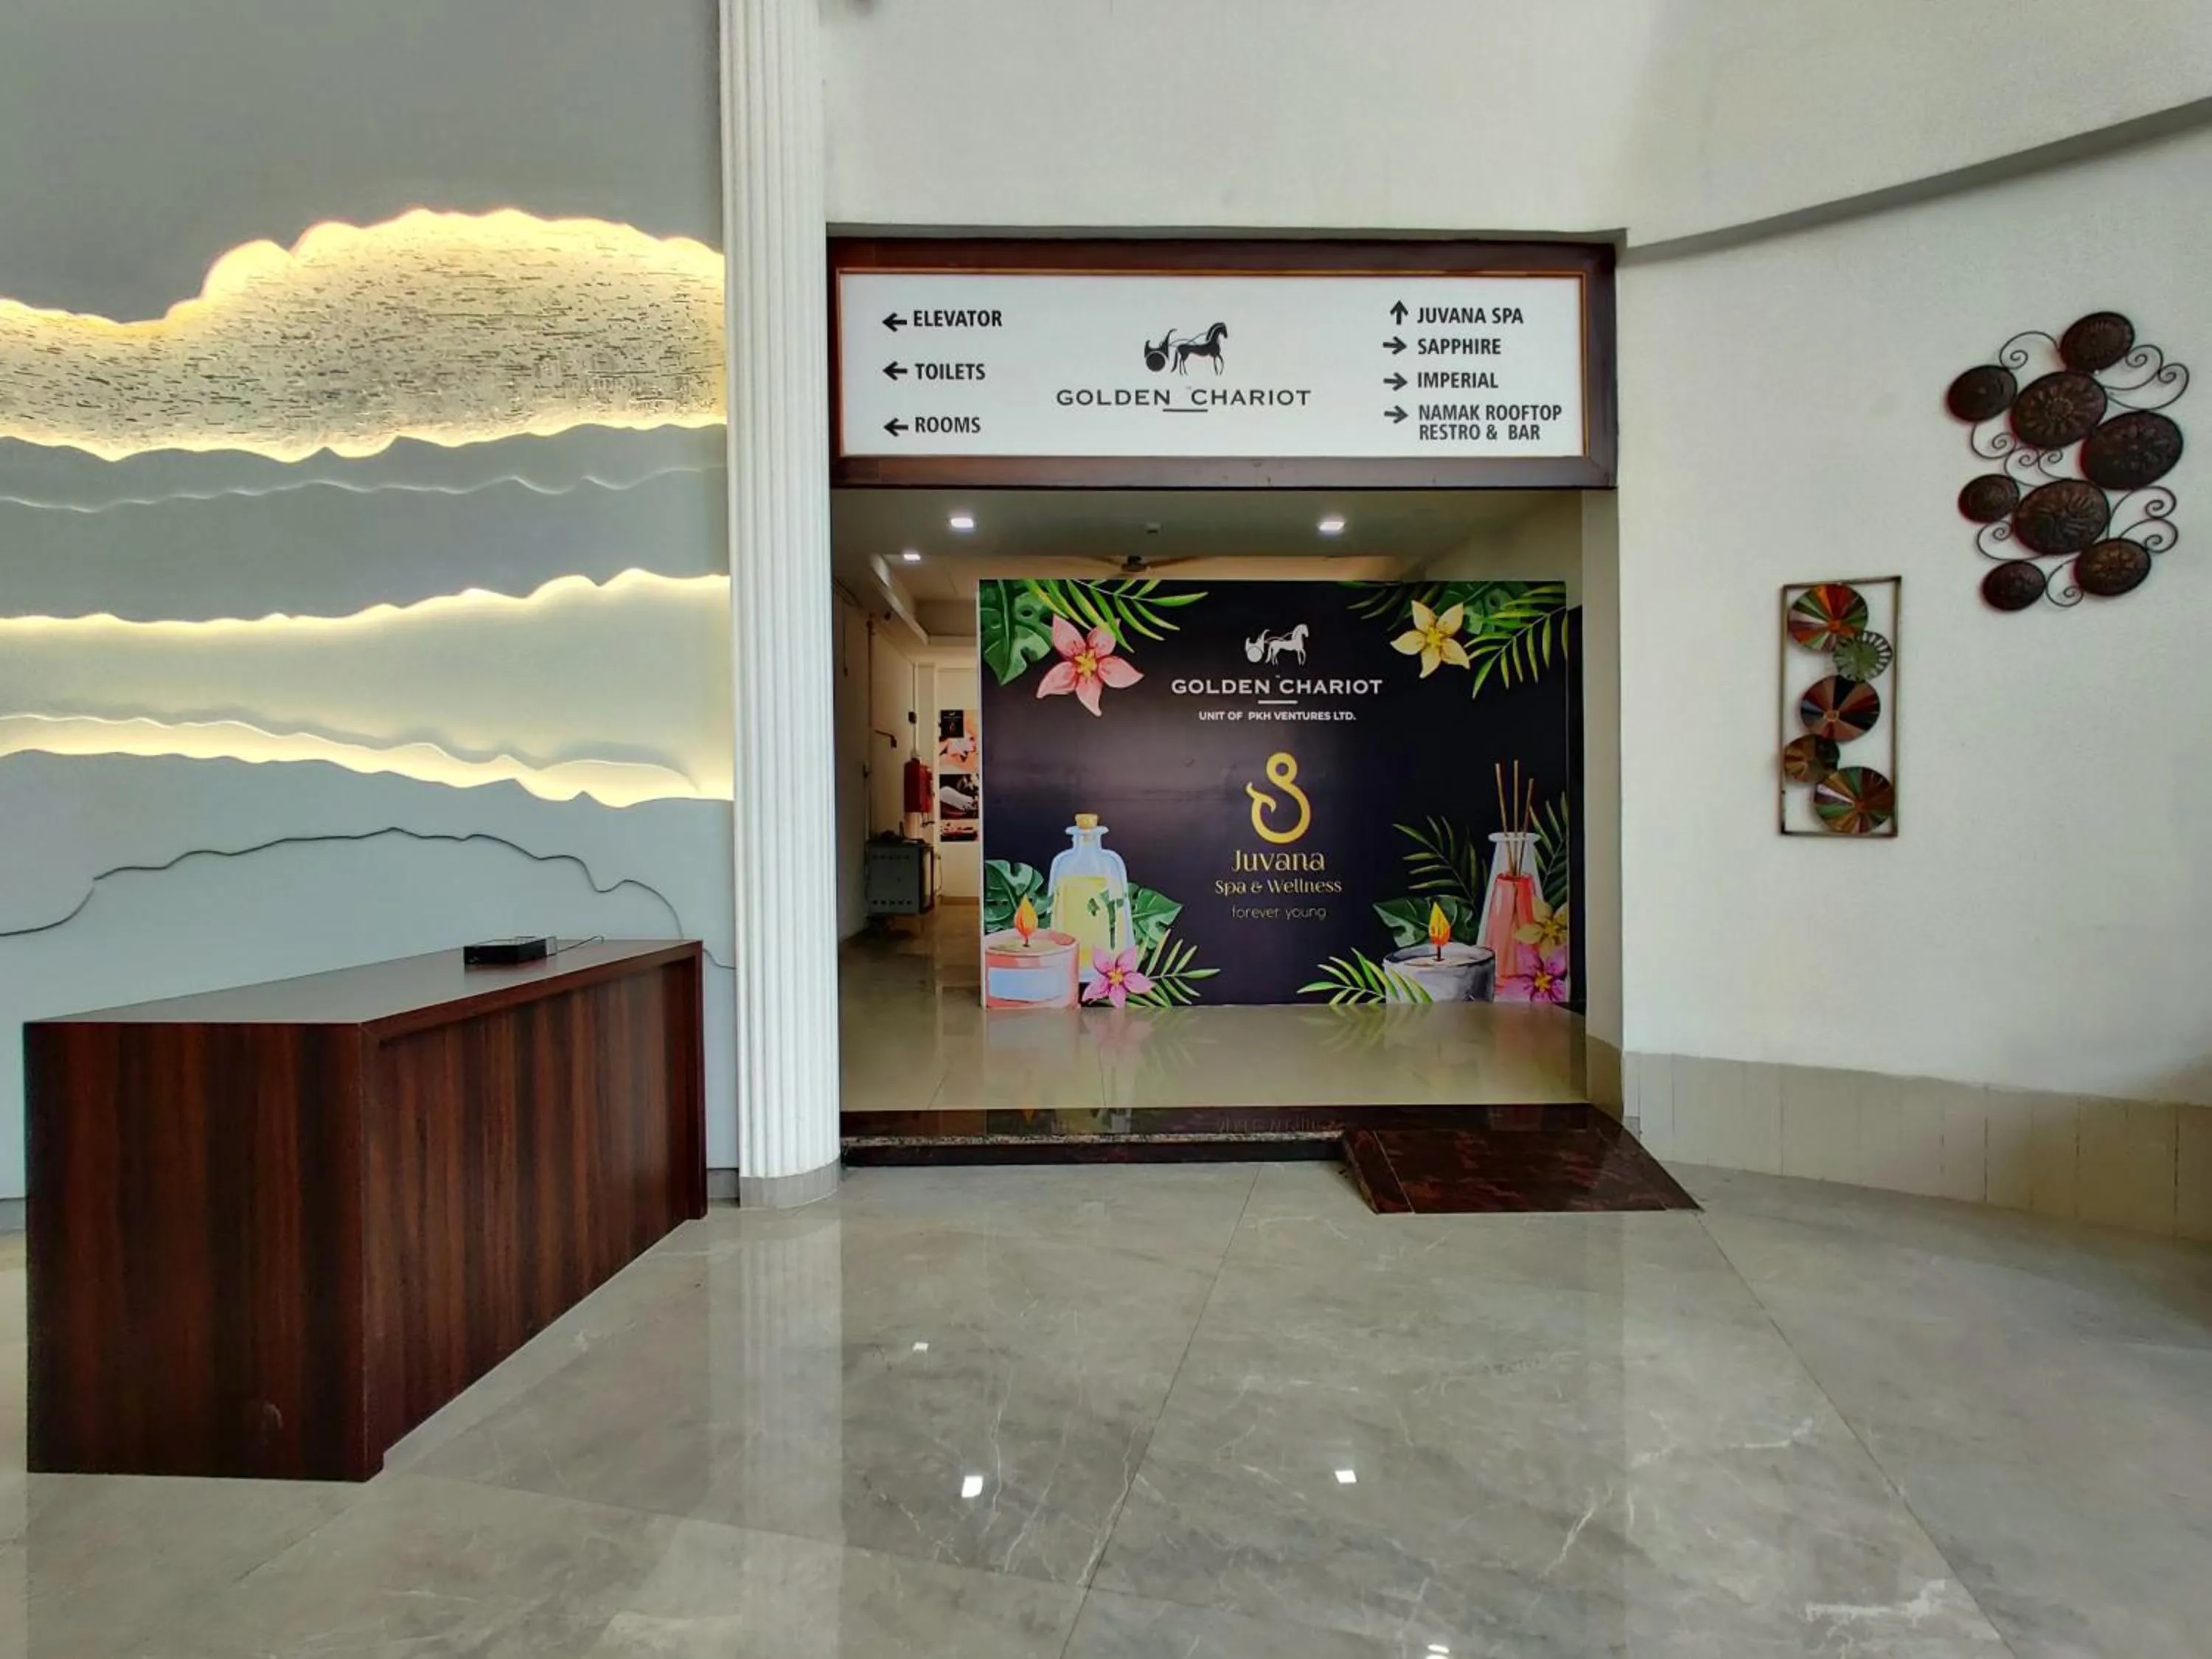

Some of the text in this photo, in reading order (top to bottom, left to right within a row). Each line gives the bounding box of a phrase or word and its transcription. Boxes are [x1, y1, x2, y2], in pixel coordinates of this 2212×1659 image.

[914, 310, 1003, 327] ELEVATOR
[1417, 307, 1524, 324] JUVANA SPA
[1417, 338, 1501, 355] SAPPHIRE
[914, 363, 986, 380] TOILETS
[1417, 372, 1499, 389] IMPERIAL
[1056, 389, 1311, 406] GOLDEN CHARIOT
[1419, 404, 1562, 421] NAMAK ROOFTOP
[915, 417, 981, 434] ROOMS
[1419, 424, 1540, 441] RESTRO & BAR
[1172, 679, 1383, 695] GOLDEN CHARIOT
[1198, 711, 1357, 720] UNIT OF PKH VENTURES LTD.
[1231, 849, 1325, 872] Juvana
[1215, 880, 1247, 897] Spa
[1266, 878, 1342, 894] Wellness
[1231, 905, 1326, 921] forever young
